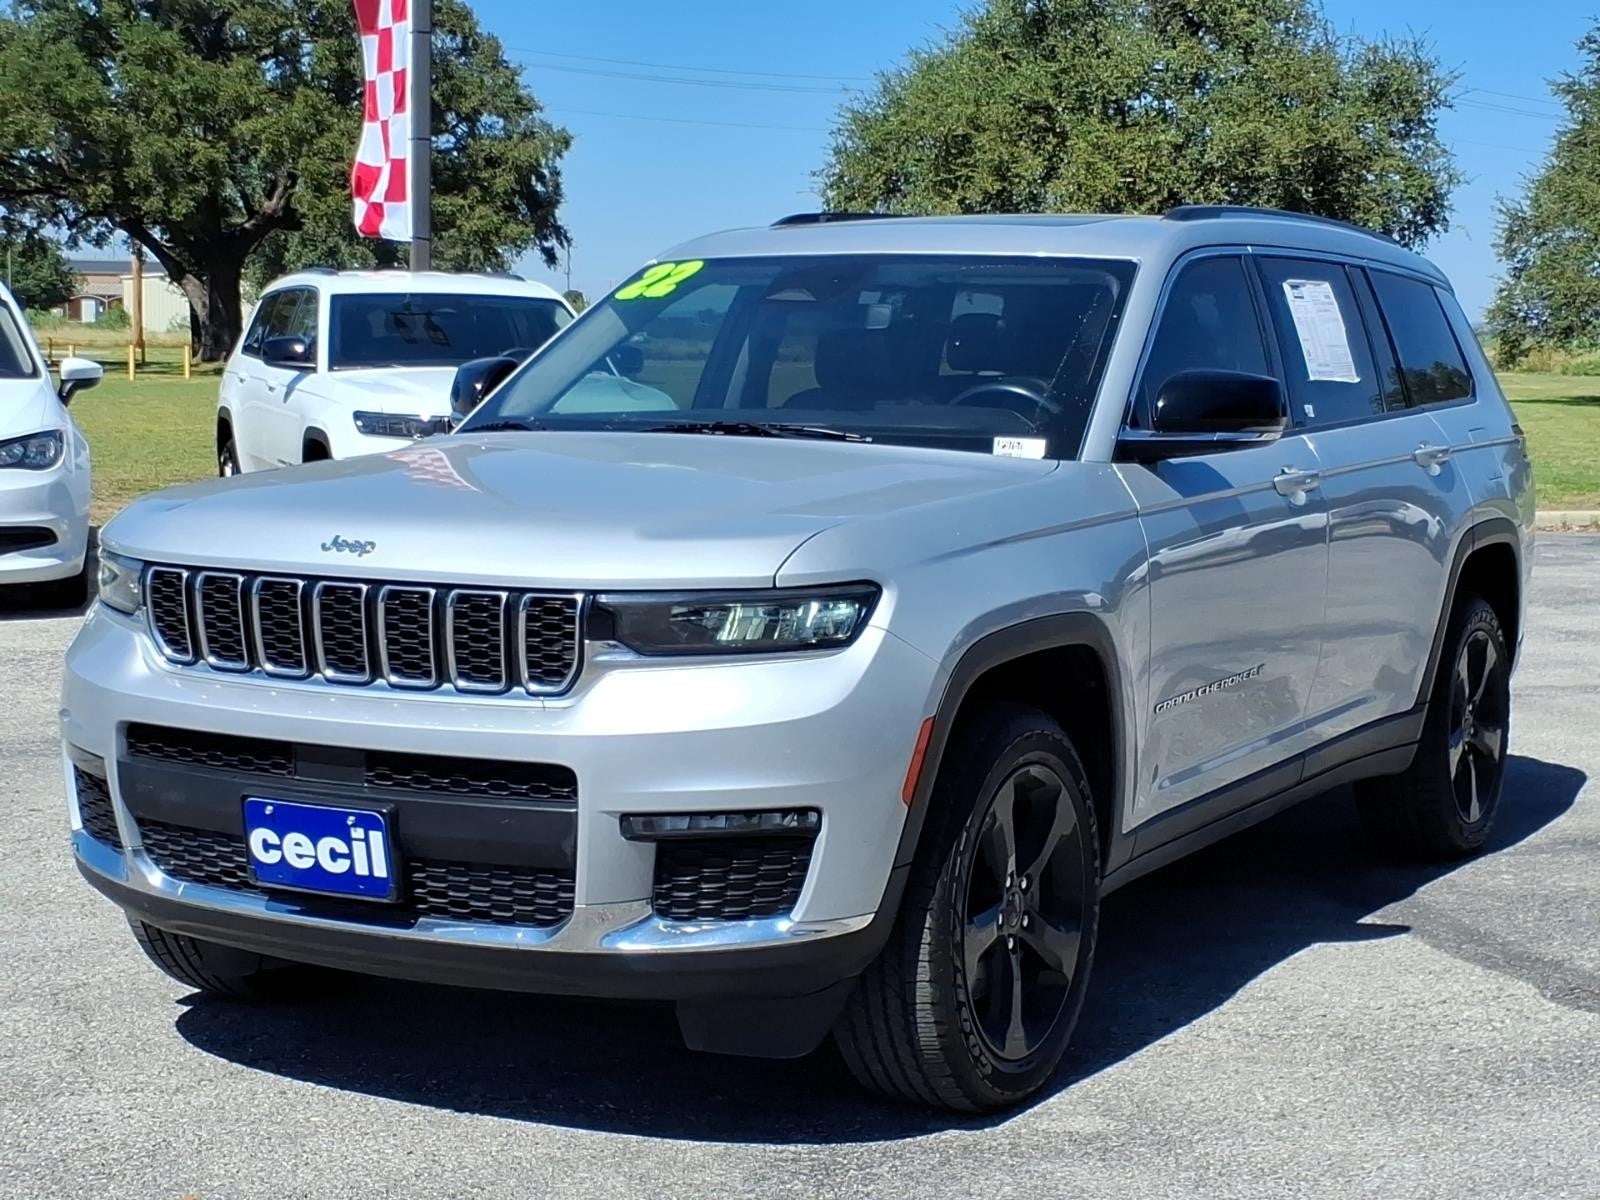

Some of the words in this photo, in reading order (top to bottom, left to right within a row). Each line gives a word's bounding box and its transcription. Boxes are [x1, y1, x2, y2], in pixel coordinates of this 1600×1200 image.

[614, 260, 705, 301] 22
[320, 534, 377, 558] Jeep
[1154, 690, 1196, 714] GRAND
[1196, 666, 1258, 697] CHEROKEE
[249, 826, 388, 878] cecil
